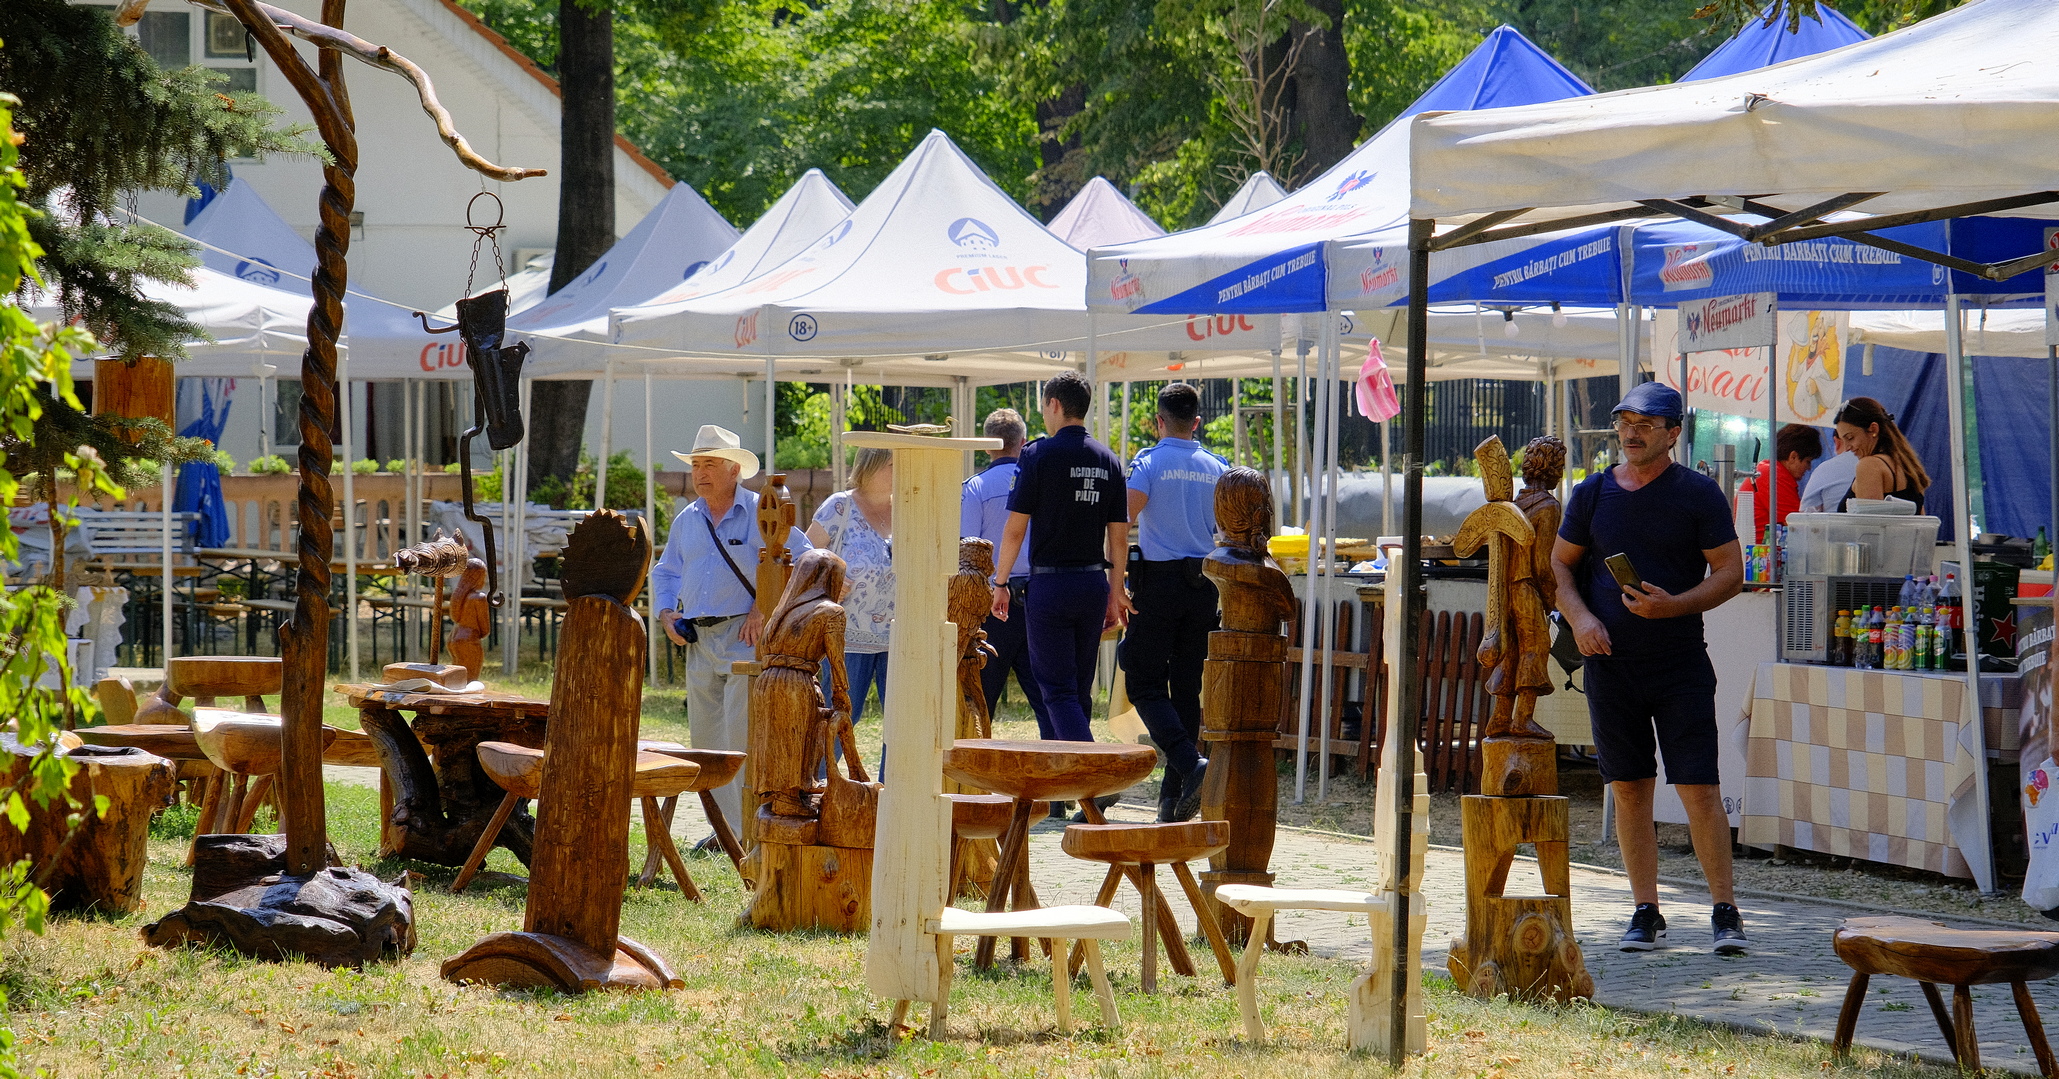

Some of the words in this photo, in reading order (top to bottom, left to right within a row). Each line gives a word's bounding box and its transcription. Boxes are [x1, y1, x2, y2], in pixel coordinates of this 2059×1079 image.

[1492, 271, 1524, 290] PENTRU
[1523, 258, 1558, 279] BĂRBAȚI
[1558, 250, 1577, 268] CUM
[1577, 236, 1611, 262] TREBUIE
[1743, 242, 1782, 263] PENTRU
[1829, 244, 1854, 264] CUM
[1855, 245, 1901, 264] TREBUIE
[1217, 281, 1244, 304] PENTRU
[1242, 269, 1271, 293] BĂRBAȚI
[1271, 262, 1286, 281] CUM
[1287, 249, 1316, 275] TREBUIE
[1702, 294, 1759, 335] Neumarkt
[795, 321, 813, 336] 18+
[420, 342, 465, 372] CiU
[1083, 478, 1095, 490] DE
[1160, 469, 1218, 485] JANDARMER
